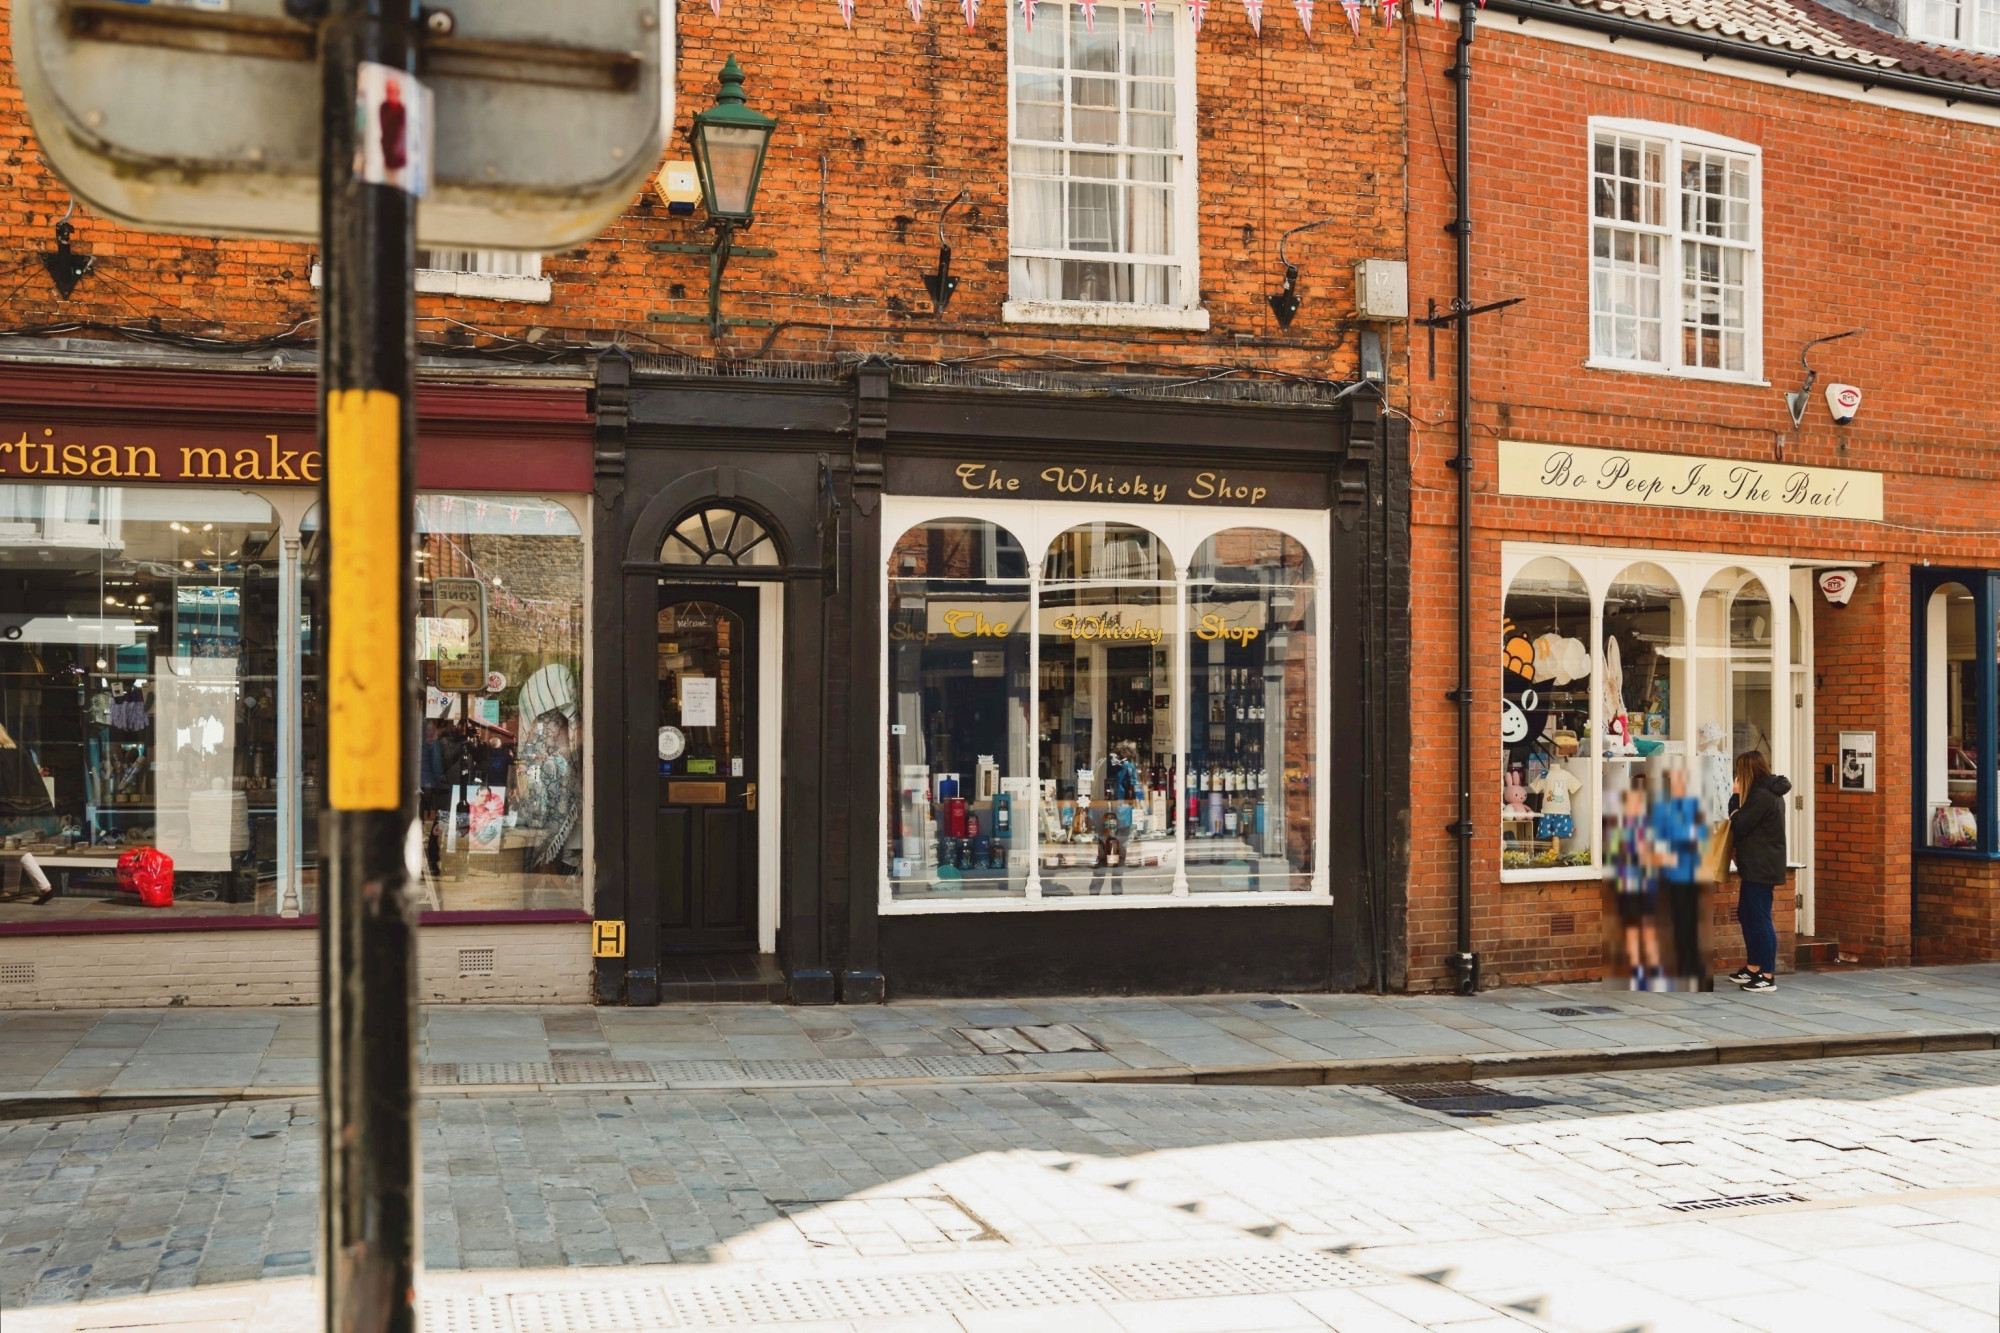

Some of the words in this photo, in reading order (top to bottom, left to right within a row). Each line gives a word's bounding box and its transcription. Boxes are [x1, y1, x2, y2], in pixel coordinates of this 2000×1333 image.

[955, 463, 1020, 491] The
[1041, 467, 1167, 502] Whisky
[1187, 472, 1266, 504] Shop
[1541, 451, 1587, 488] Bo
[1596, 456, 1664, 501] Peep
[1672, 463, 1713, 496] In
[1723, 466, 1771, 502] The
[1782, 471, 1849, 508] Bail
[943, 608, 1009, 639] The
[1054, 611, 1163, 646] Whisky
[1196, 613, 1258, 647] Shop
[597, 924, 620, 953] H
